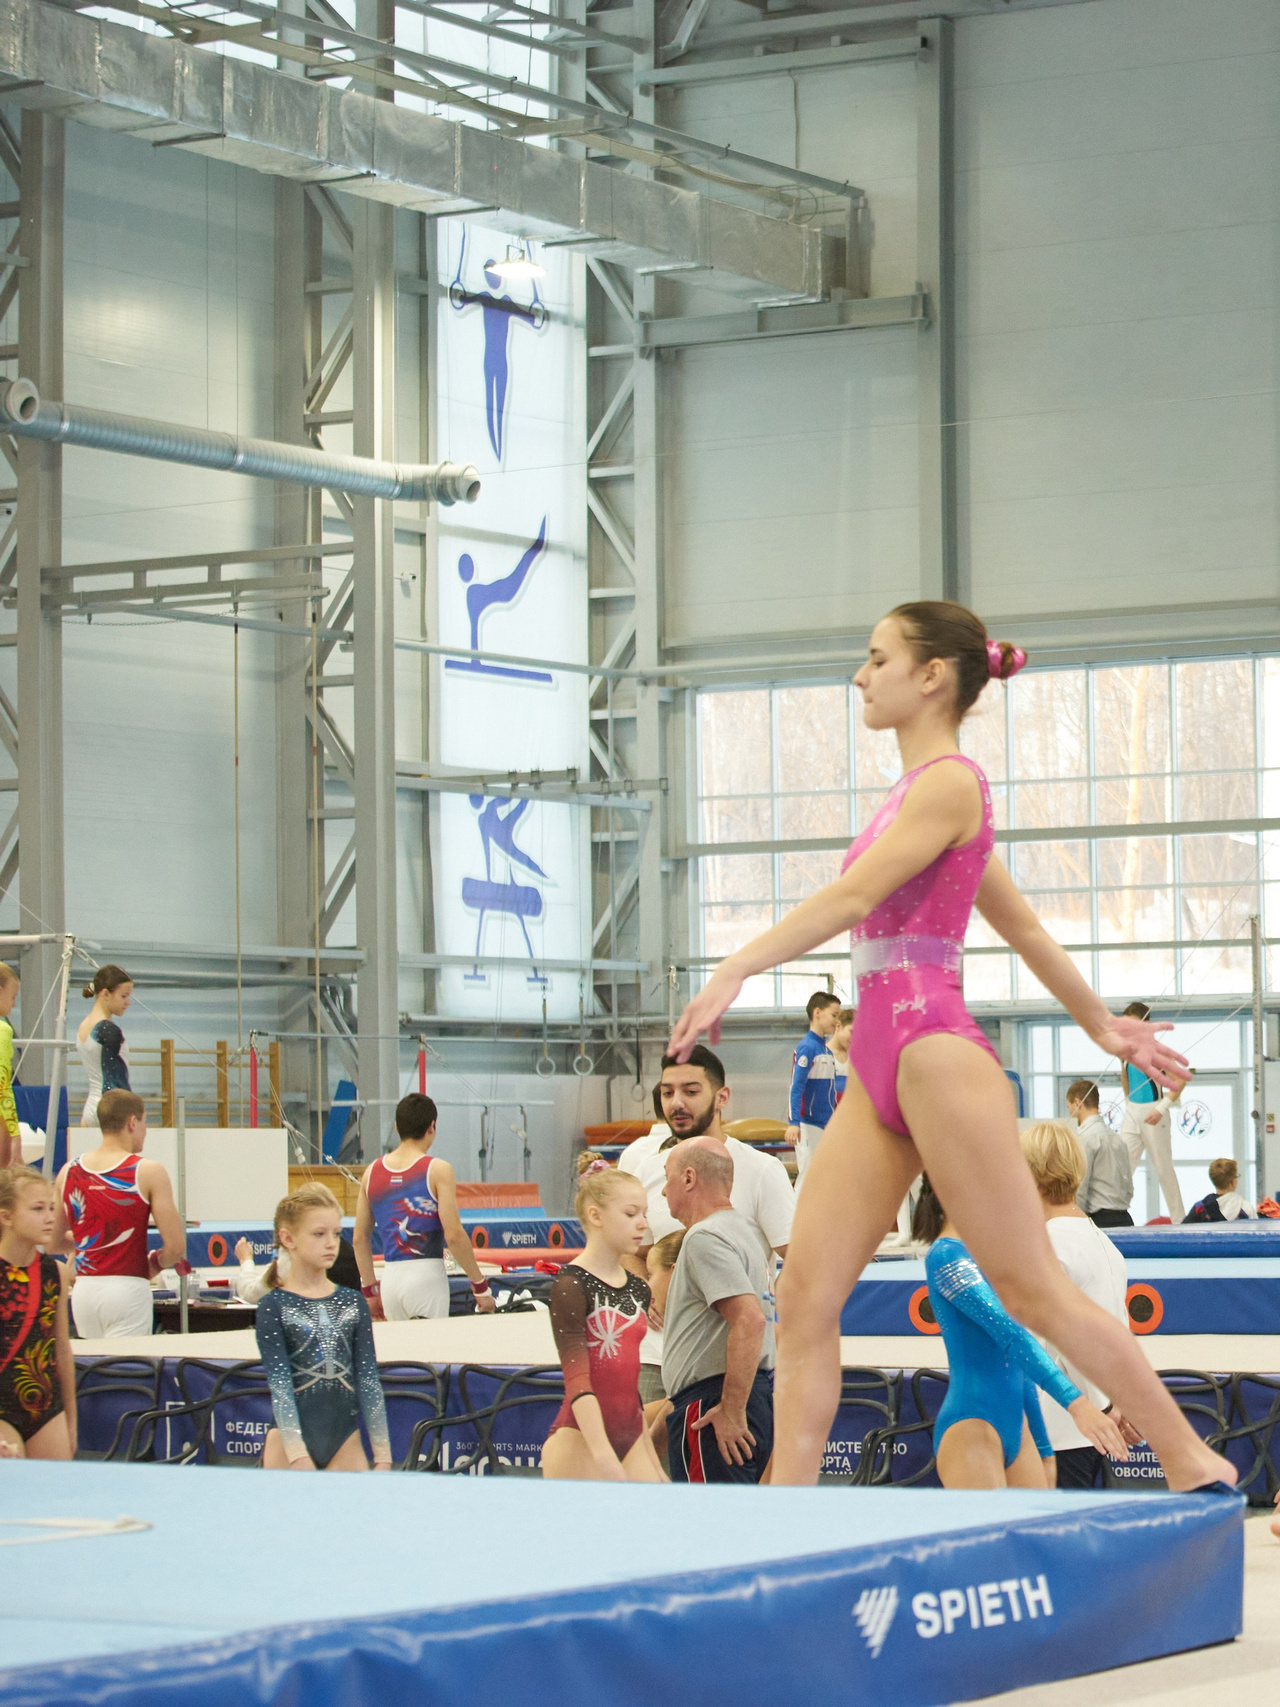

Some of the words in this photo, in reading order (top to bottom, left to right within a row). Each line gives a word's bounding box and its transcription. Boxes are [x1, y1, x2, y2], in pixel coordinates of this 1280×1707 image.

[892, 994, 927, 1029] pink
[511, 1233, 537, 1245] SPIETH
[226, 1441, 264, 1454] СПОР
[1112, 1467, 1165, 1478] ОВОСИБ
[911, 1574, 1054, 1639] SPIETH
